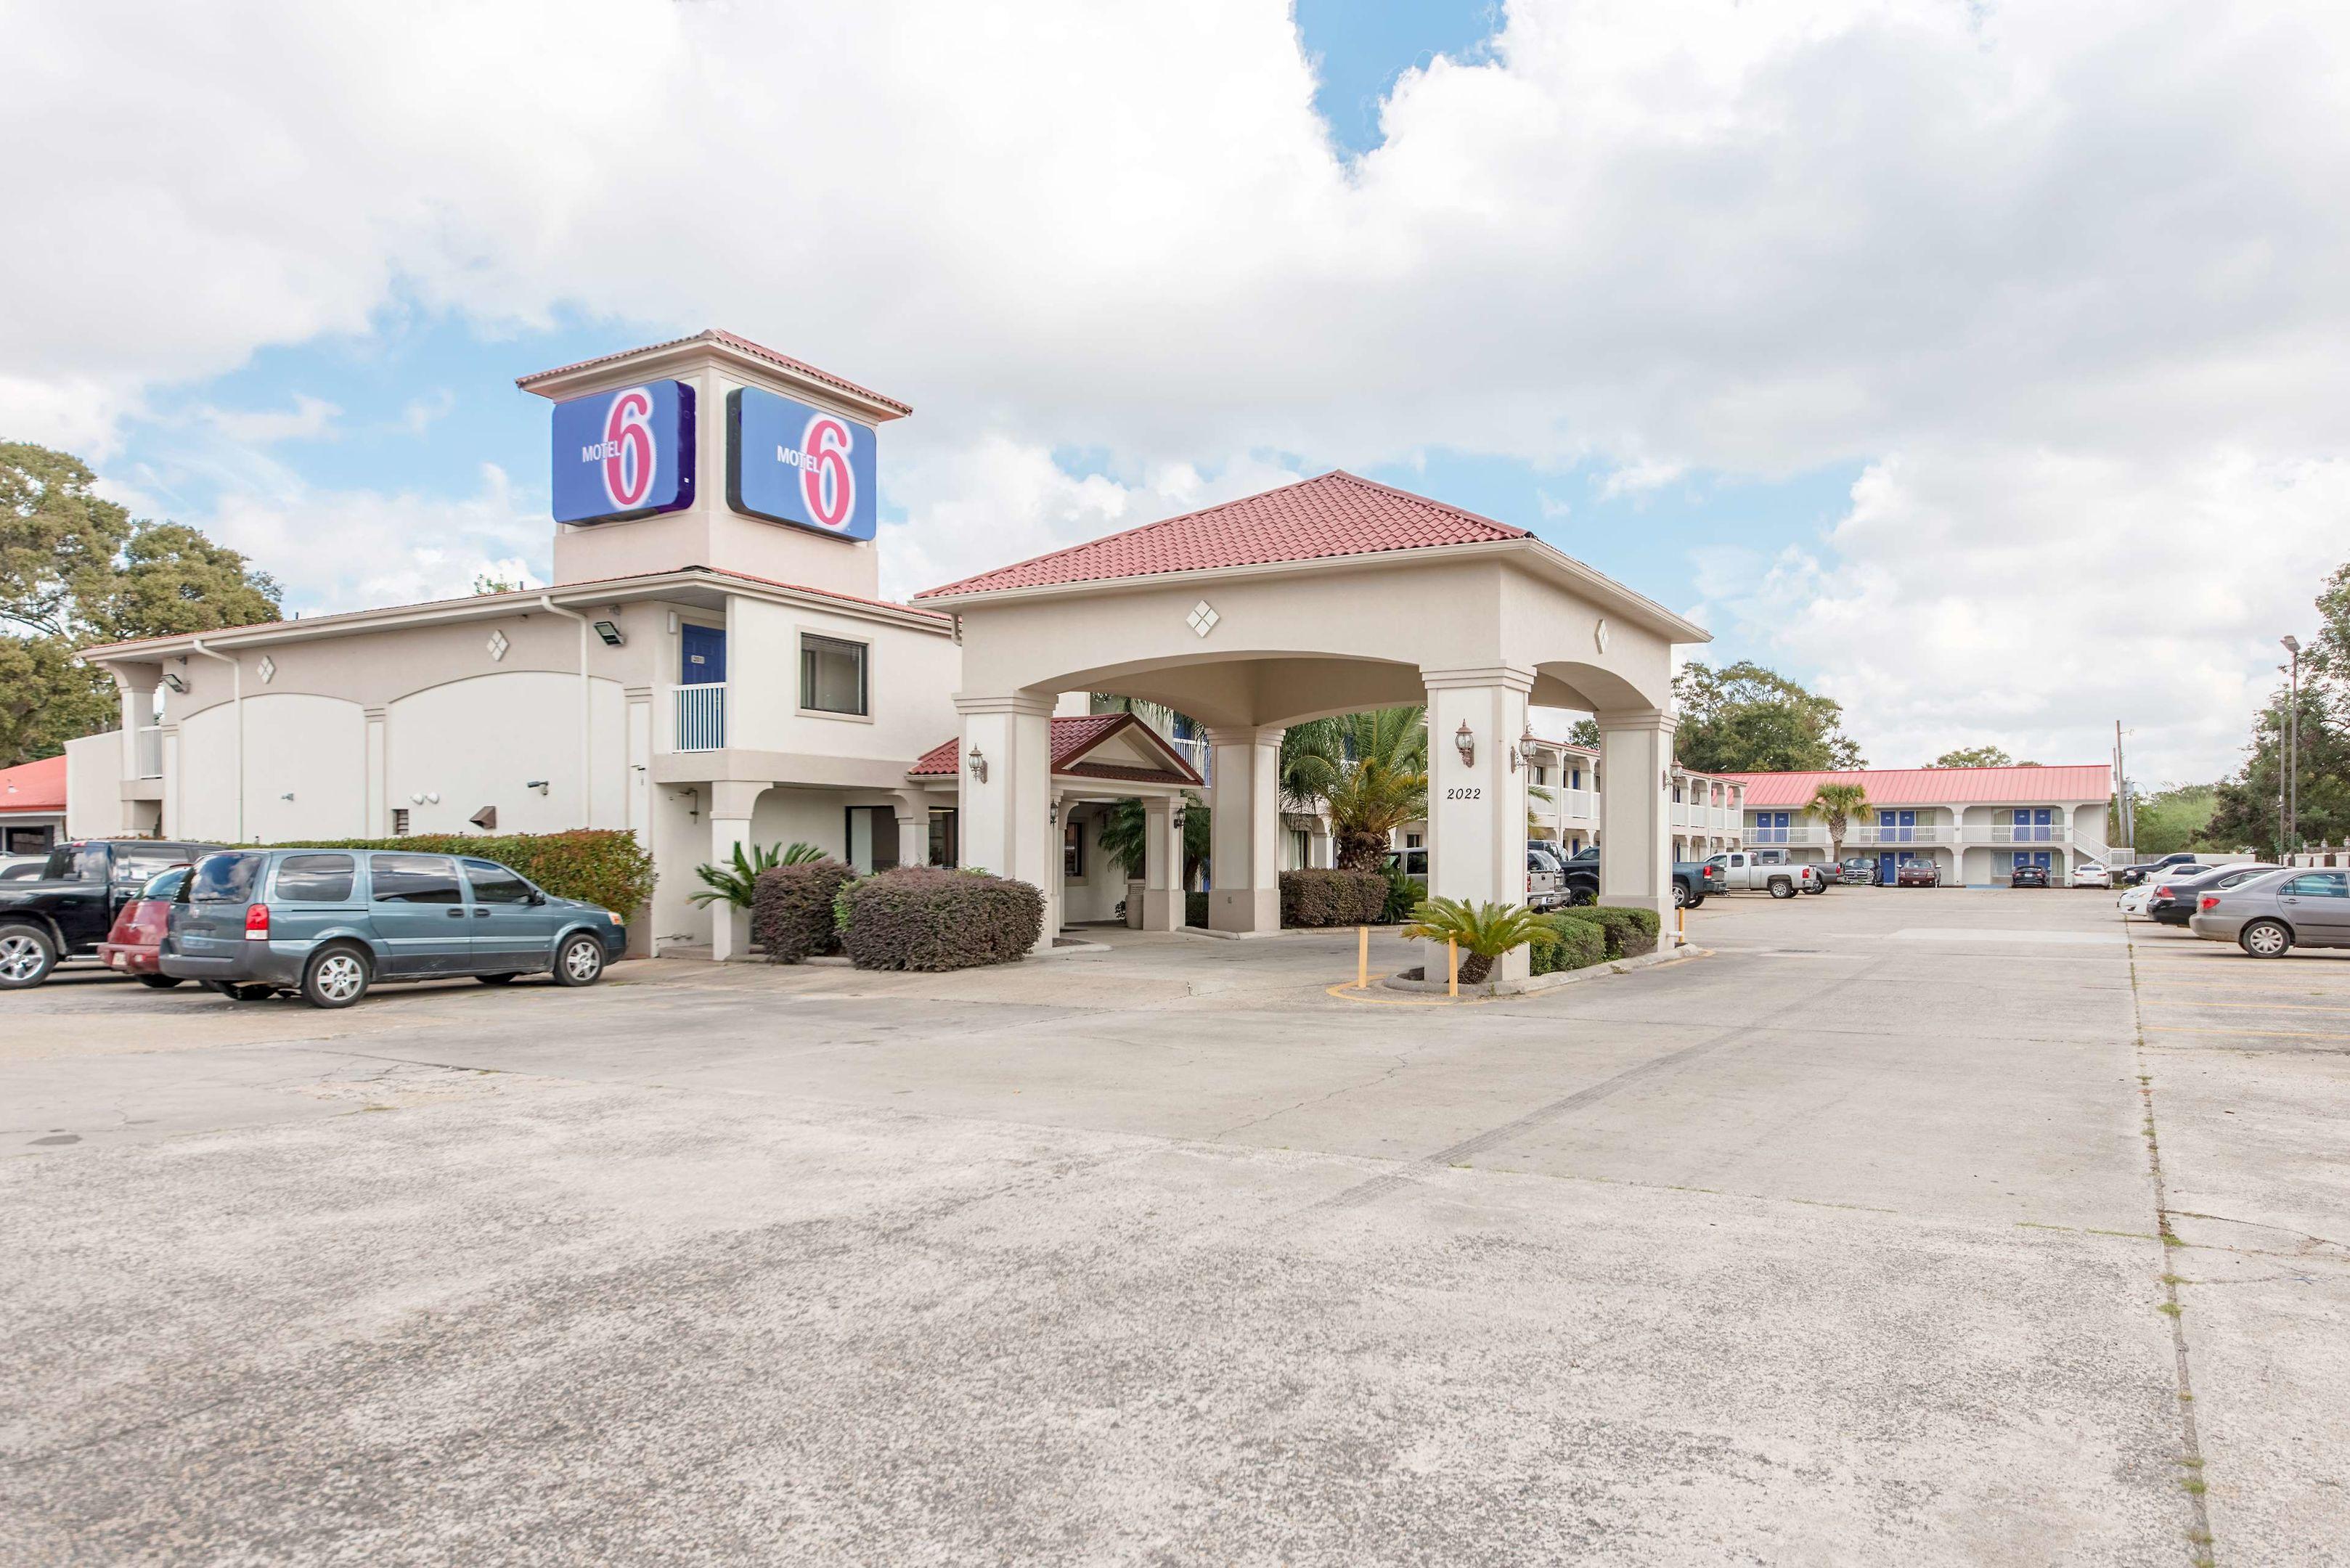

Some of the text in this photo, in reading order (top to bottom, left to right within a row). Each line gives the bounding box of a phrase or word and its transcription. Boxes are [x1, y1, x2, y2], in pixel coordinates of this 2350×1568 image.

[582, 392, 652, 506] MOTEL 6
[777, 419, 851, 526] MOTEL 6
[1448, 788, 1481, 799] 2022
